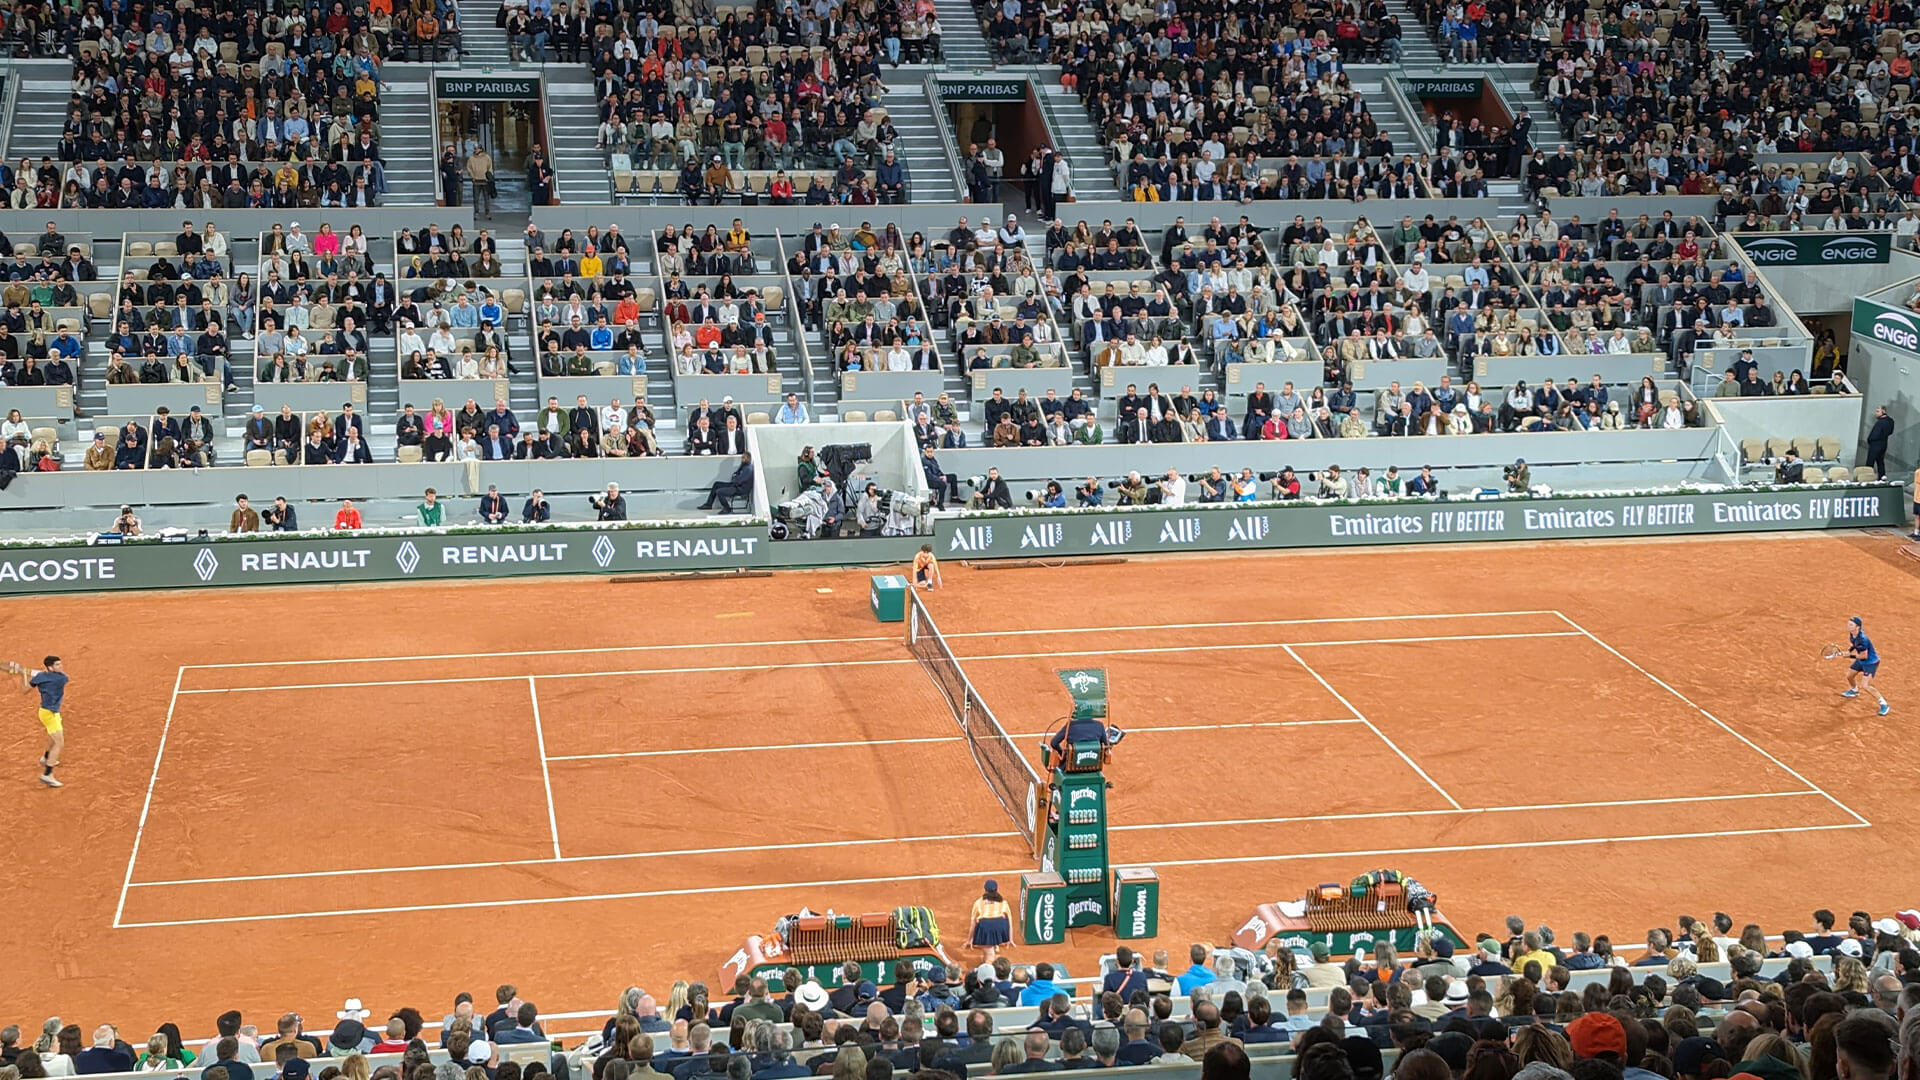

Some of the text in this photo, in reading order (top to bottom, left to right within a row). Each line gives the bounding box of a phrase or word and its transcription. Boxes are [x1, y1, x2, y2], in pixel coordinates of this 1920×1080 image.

[445, 83, 530, 93] BNP PARIBAS
[940, 84, 1018, 95] BNP PARIBAS
[1427, 83, 1475, 92] PARIBAS
[1523, 503, 1694, 530] Emirates FLY BETTER
[1712, 496, 1879, 523] Emirates FLY BETTER
[1329, 510, 1504, 536] Emirates FLY BETTER
[442, 543, 569, 564] RENAULT
[636, 537, 758, 558] RENAULT
[241, 549, 372, 571] RENAULT
[1132, 888, 1147, 937] Wilson
